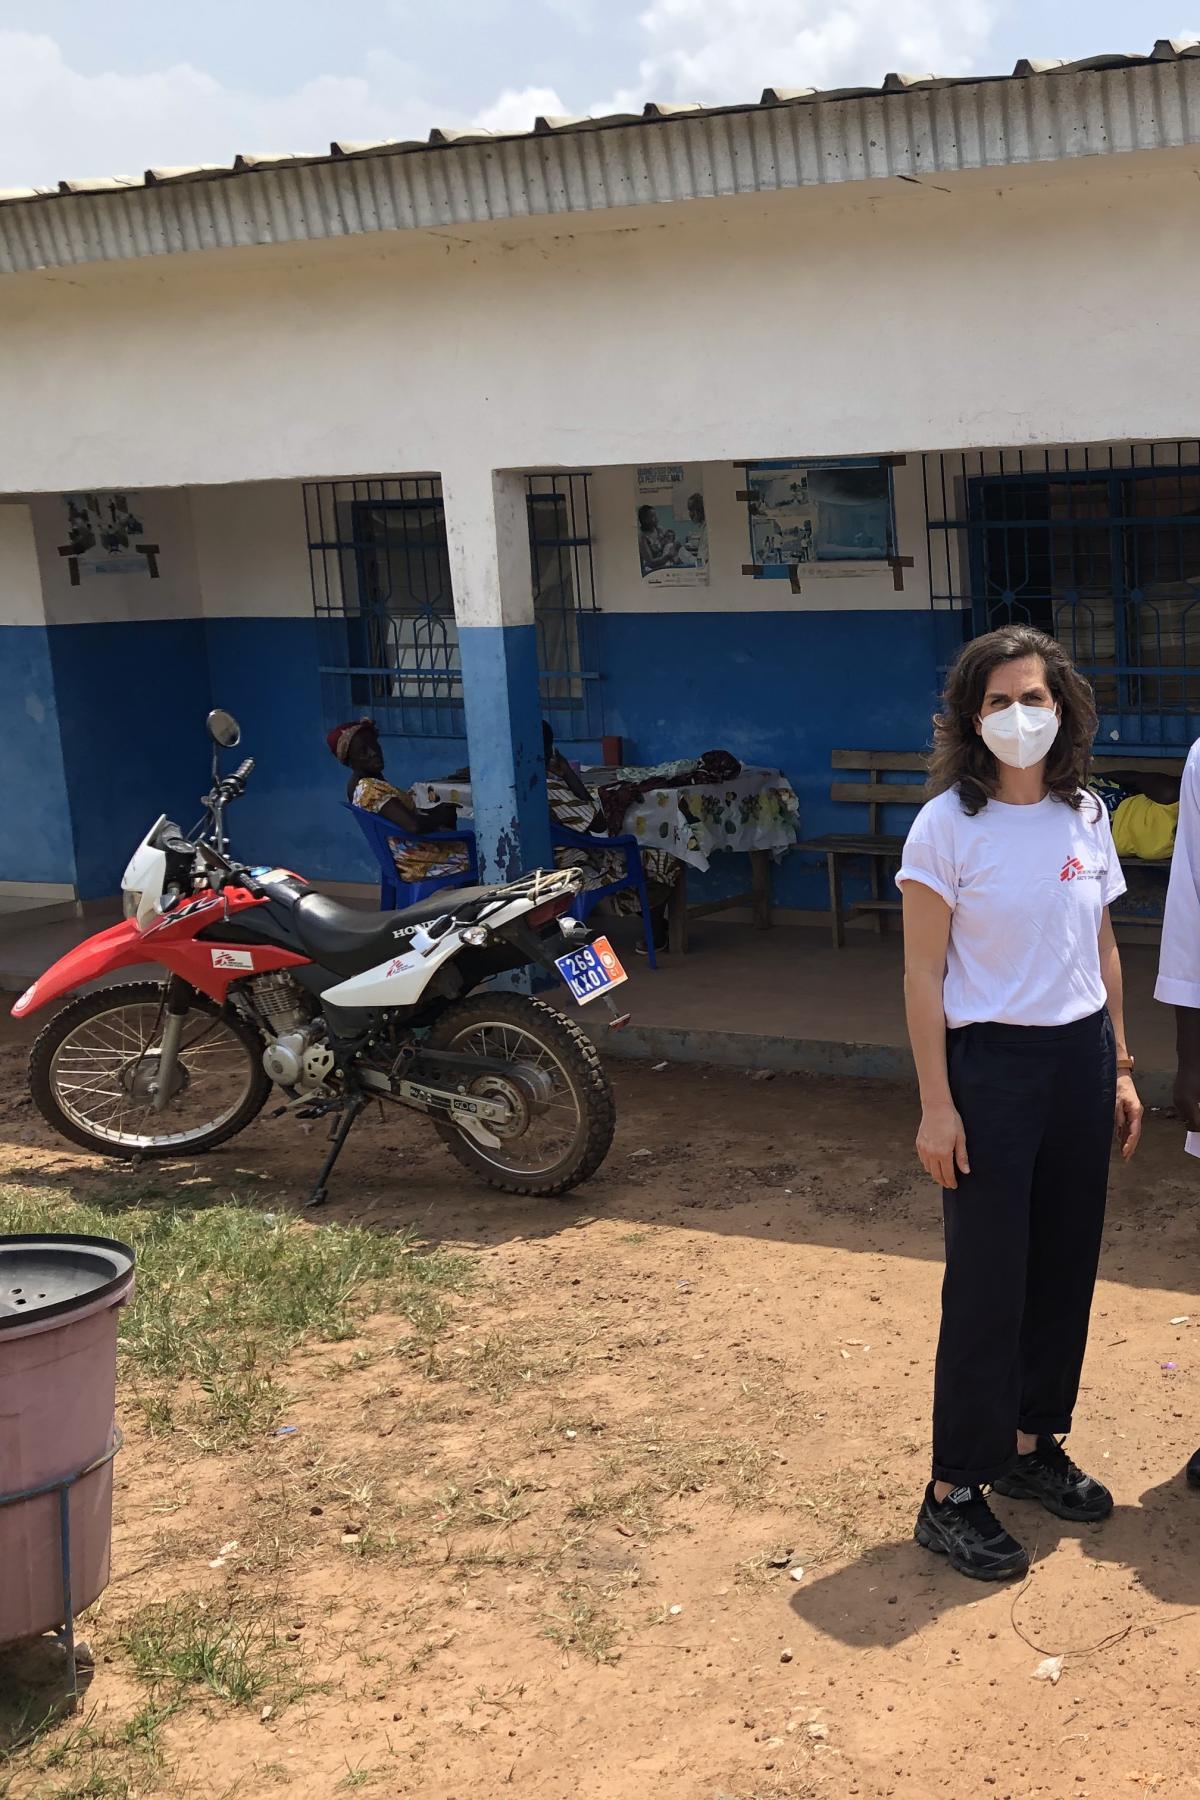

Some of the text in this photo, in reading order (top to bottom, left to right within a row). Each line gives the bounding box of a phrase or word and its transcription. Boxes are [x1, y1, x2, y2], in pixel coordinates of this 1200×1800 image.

[391, 919, 437, 939] HON
[566, 950, 596, 975] 269
[571, 966, 608, 996] KX01
